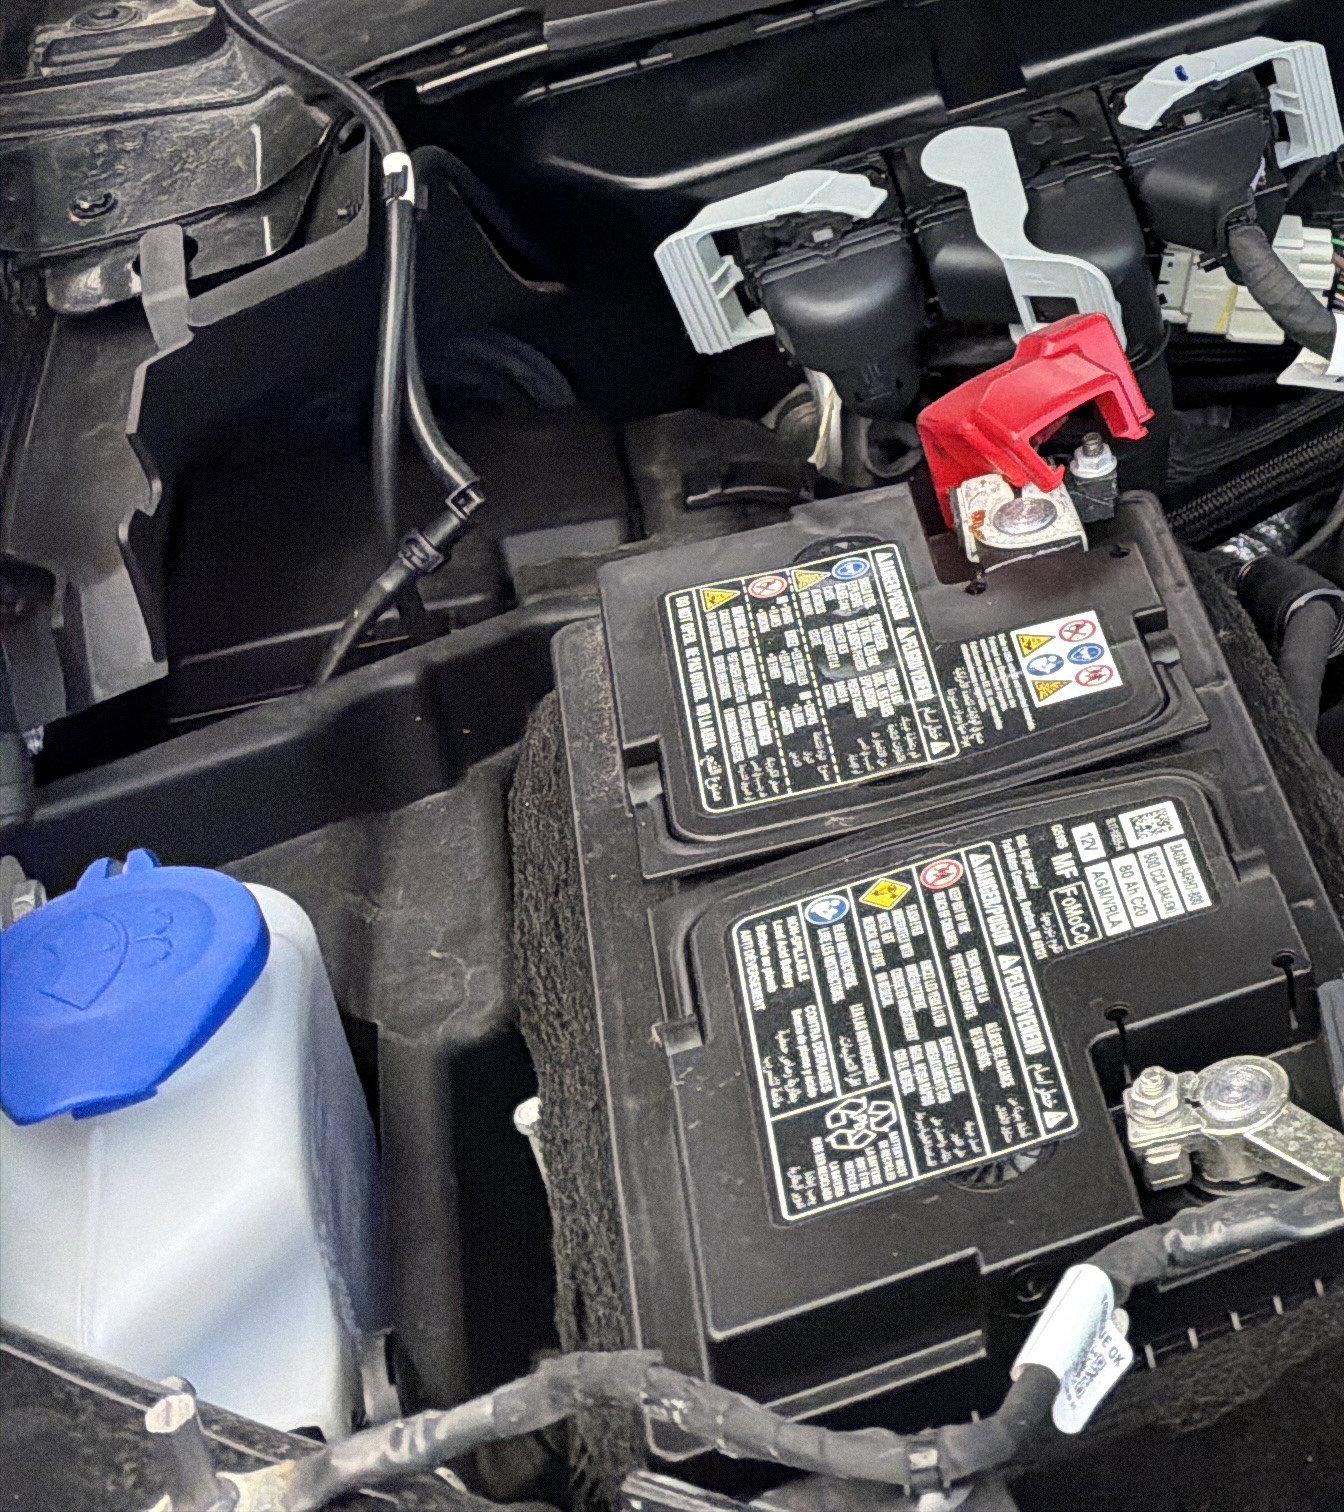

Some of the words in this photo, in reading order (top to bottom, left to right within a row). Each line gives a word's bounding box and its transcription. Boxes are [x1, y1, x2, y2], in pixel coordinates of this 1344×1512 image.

[1078, 831, 1098, 853] 12V
[1050, 851, 1079, 881] MF
[1118, 863, 1135, 879] 80
[1143, 851, 1161, 869] 800
[1123, 879, 1141, 895] Ah
[1148, 868, 1167, 886] CCA
[1091, 868, 1123, 929] AGM/VRLA
[1129, 895, 1149, 917] C20
[1057, 885, 1093, 945] FoMoCo
[785, 914, 810, 982] NON-SPILLABLE
[972, 862, 1014, 947] DANGER/POISON
[1001, 965, 1046, 1056] PELIGRO/VENENO
[803, 1003, 822, 1041] CONTRA
[811, 1039, 833, 1094] DERRAMES
